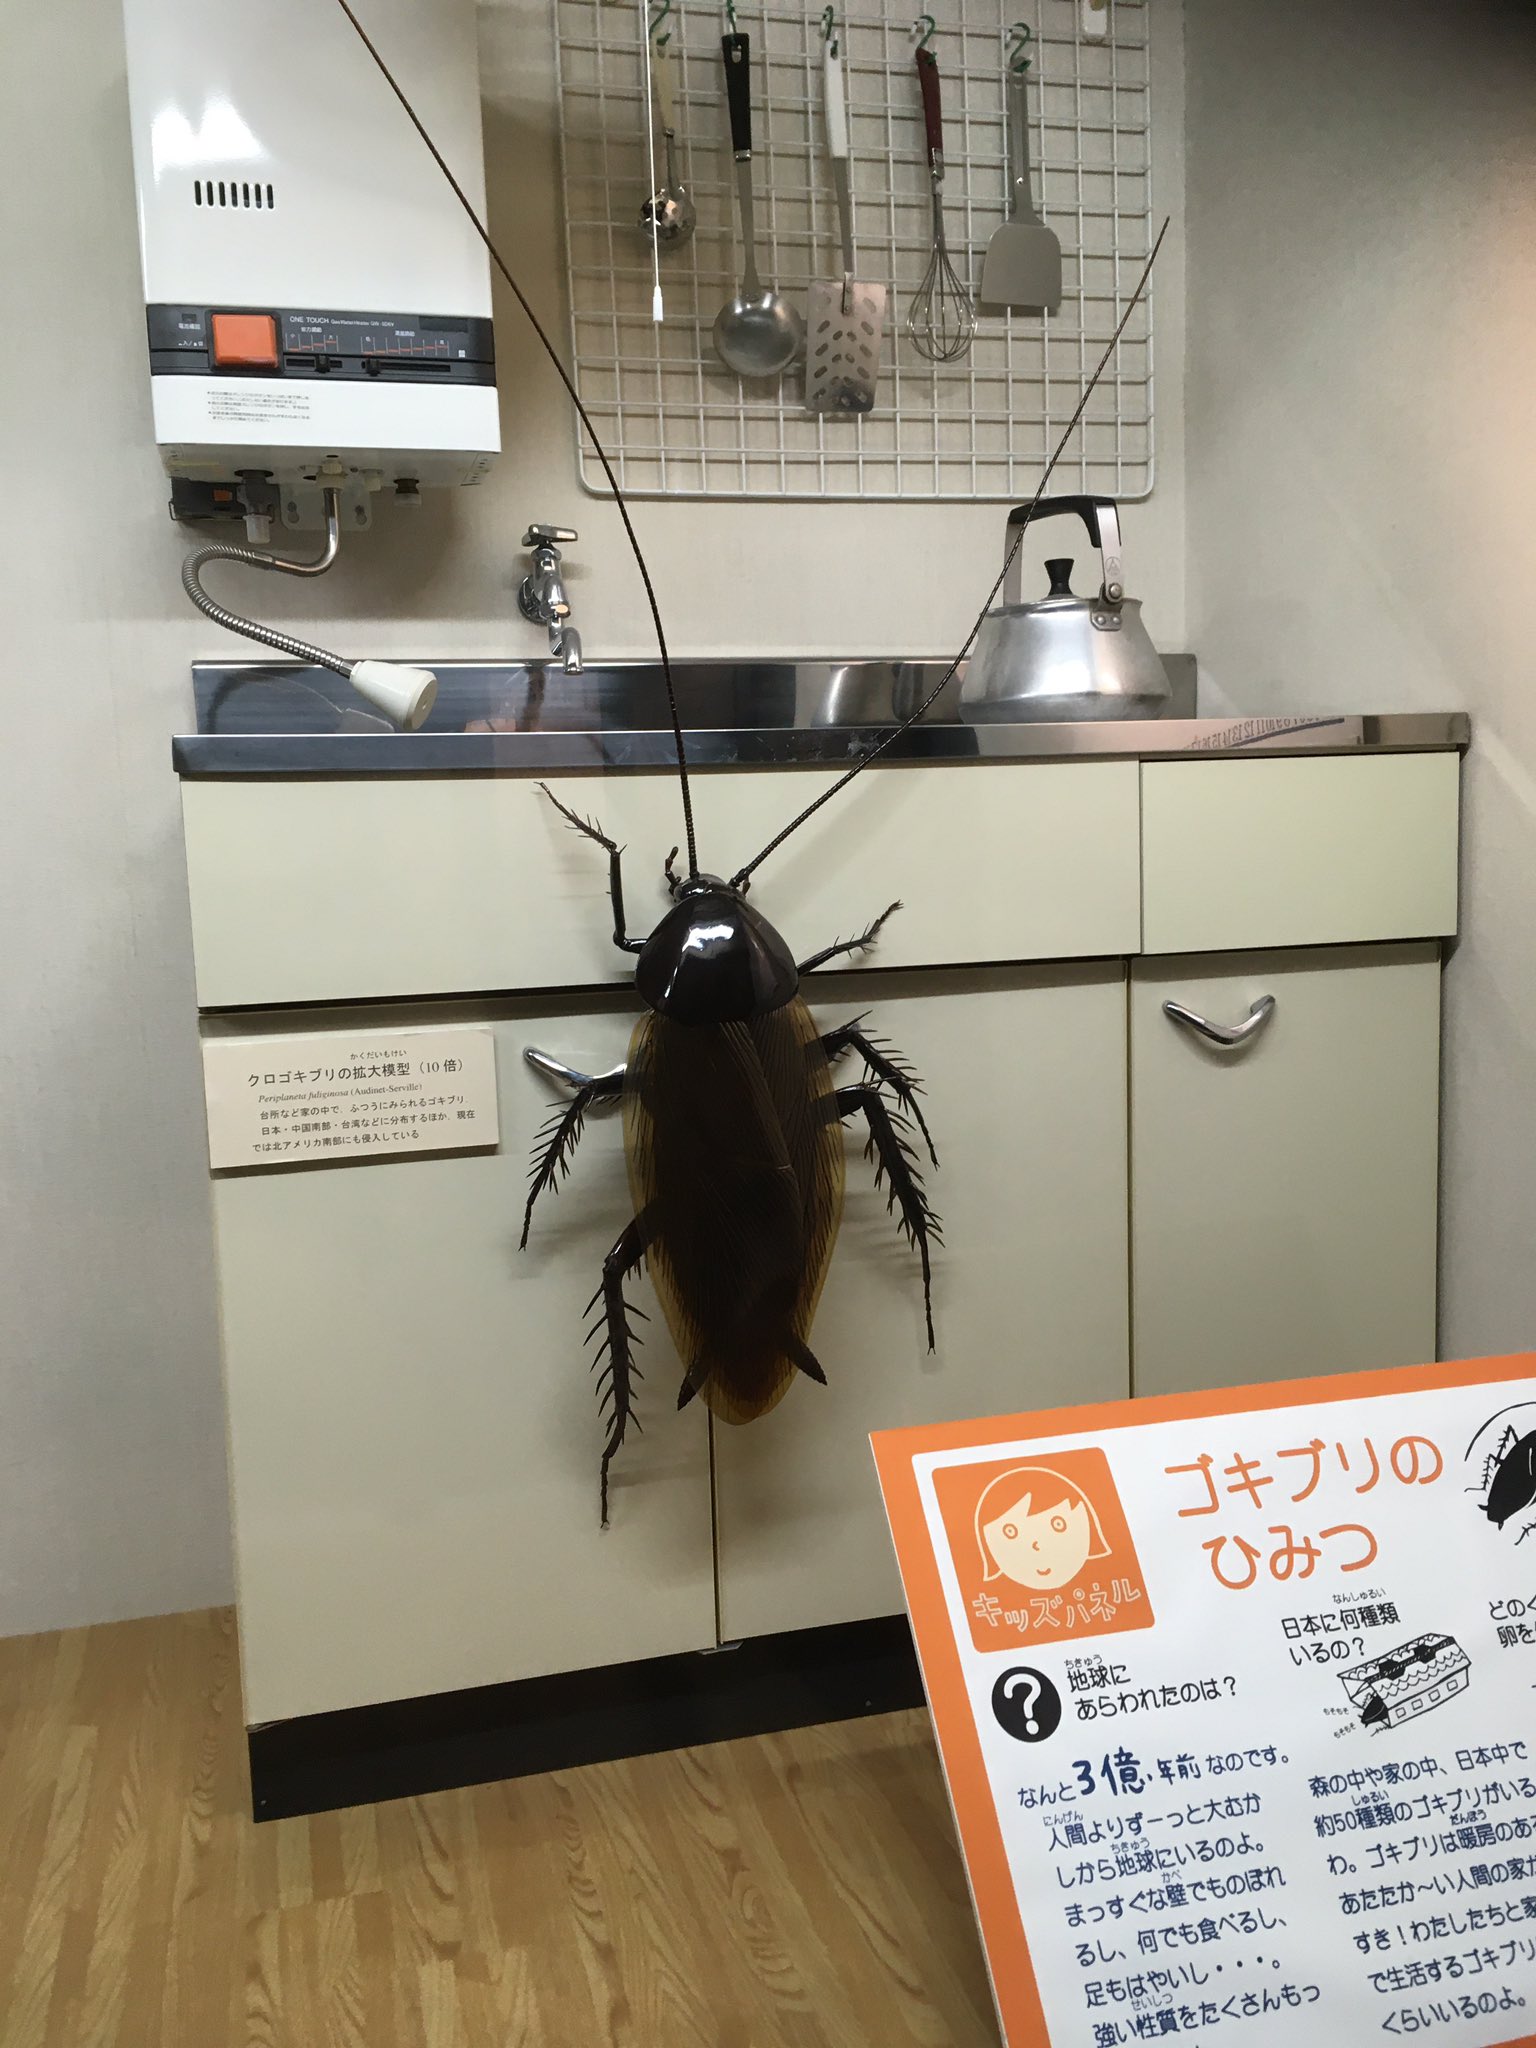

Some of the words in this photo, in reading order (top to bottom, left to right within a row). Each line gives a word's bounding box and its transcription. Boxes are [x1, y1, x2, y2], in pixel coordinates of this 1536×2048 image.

[350, 1050, 406, 1060] かくだいもけい
[258, 1092, 308, 1104] Periplaneta
[308, 1090, 348, 1102] fuliginosa
[252, 1130, 419, 1152] では北アメリカ南部にも侵入している
[1164, 1436, 1443, 1517] ゴキブリの
[1202, 1523, 1378, 1590] ひみつ
[972, 1578, 1140, 1632] キッズパネル
[1332, 1588, 1386, 1604] なんしゅるい
[1281, 1602, 1400, 1639] 日本に何種類
[1496, 1621, 1536, 1648] 卵を
[1064, 1654, 1103, 1669] ちきゅう
[1290, 1637, 1364, 1666] いるの？
[1067, 1664, 1131, 1693] 地球に
[1074, 1676, 1236, 1720] あらわれたのは？
[1323, 1708, 1350, 1716] もそもそ
[1334, 1722, 1356, 1739] もそもそ
[1308, 1741, 1528, 1798] 森の中や家の中、日本中で
[1351, 1790, 1390, 1806] しゅるい
[1042, 1810, 1084, 1827] にんげん
[1048, 1792, 1261, 1852] 人間よりずーっと大むか
[1110, 1837, 1150, 1854] ちきゅう
[1056, 1832, 1264, 1889] しから地球にいるのよ。
[1161, 1870, 1182, 1884] かべ
[1064, 1866, 1286, 1928] まっすぐな壁でものぼれ
[1131, 1992, 1173, 2010] せいしつ
[1382, 1986, 1526, 2034] くらいいるのよ。
[1092, 1984, 1321, 2048] 強い性質をたくさんもっ
